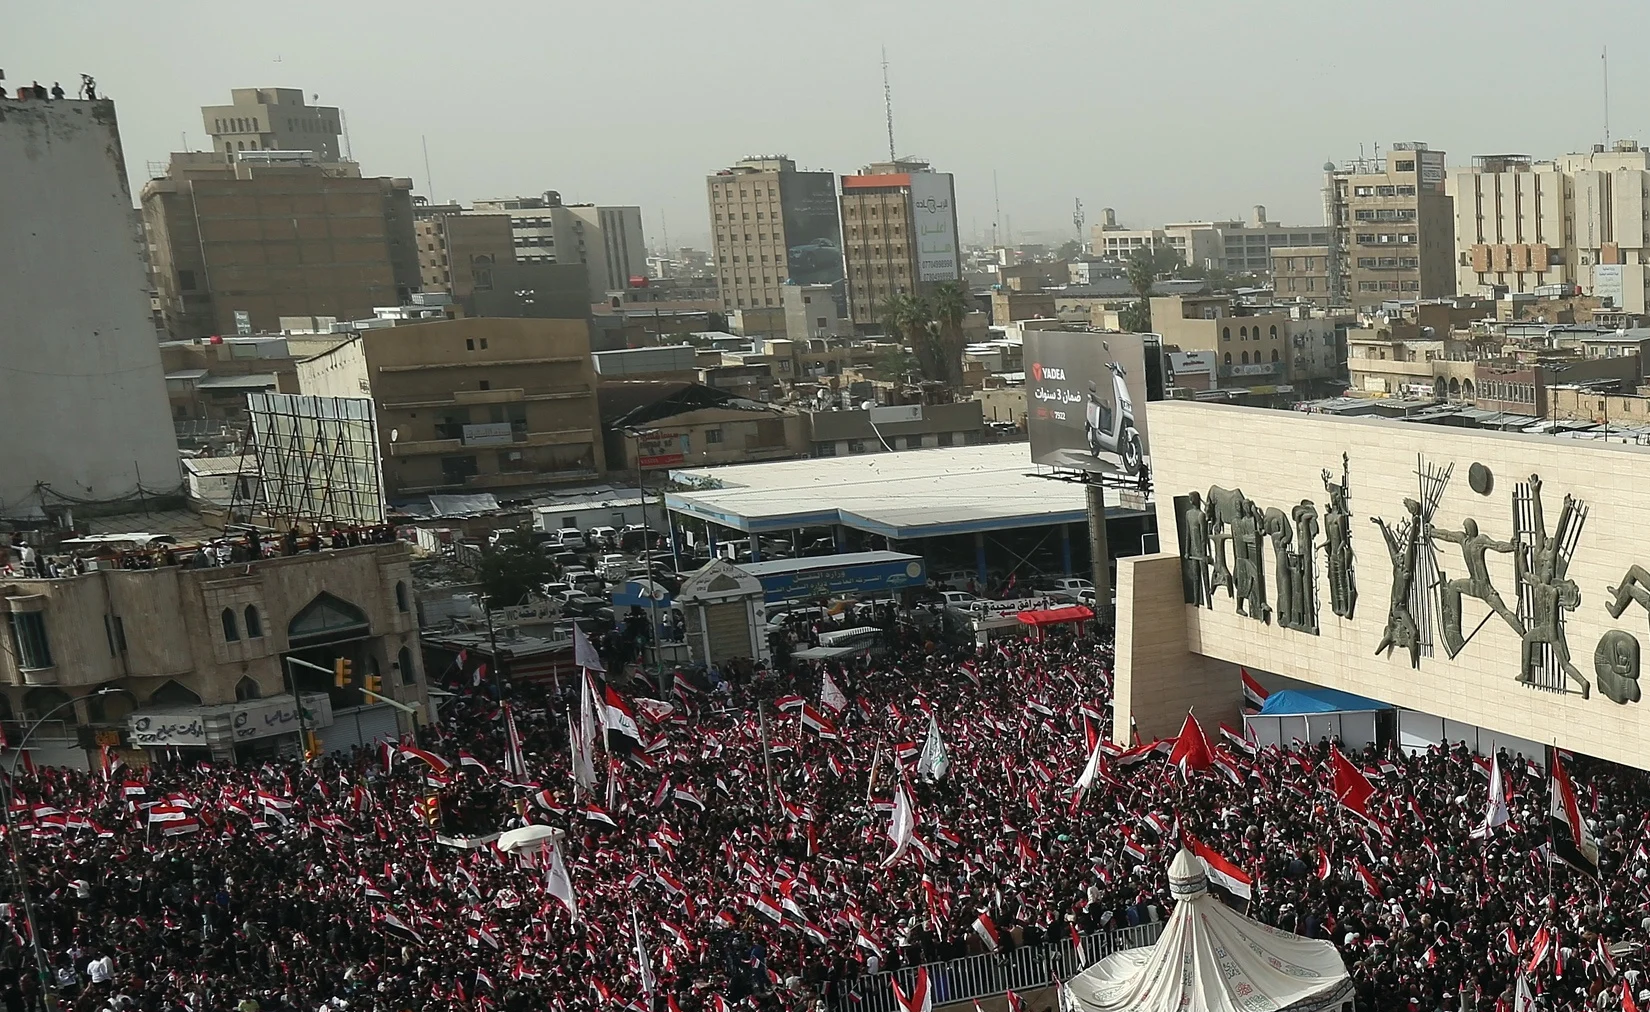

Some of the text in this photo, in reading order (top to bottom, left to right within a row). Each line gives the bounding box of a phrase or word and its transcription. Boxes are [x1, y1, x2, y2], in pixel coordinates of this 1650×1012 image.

[1042, 367, 1066, 380] YADEA
[1034, 387, 1082, 404] ضمان 3 سنوات
[506, 609, 518, 620] WC
